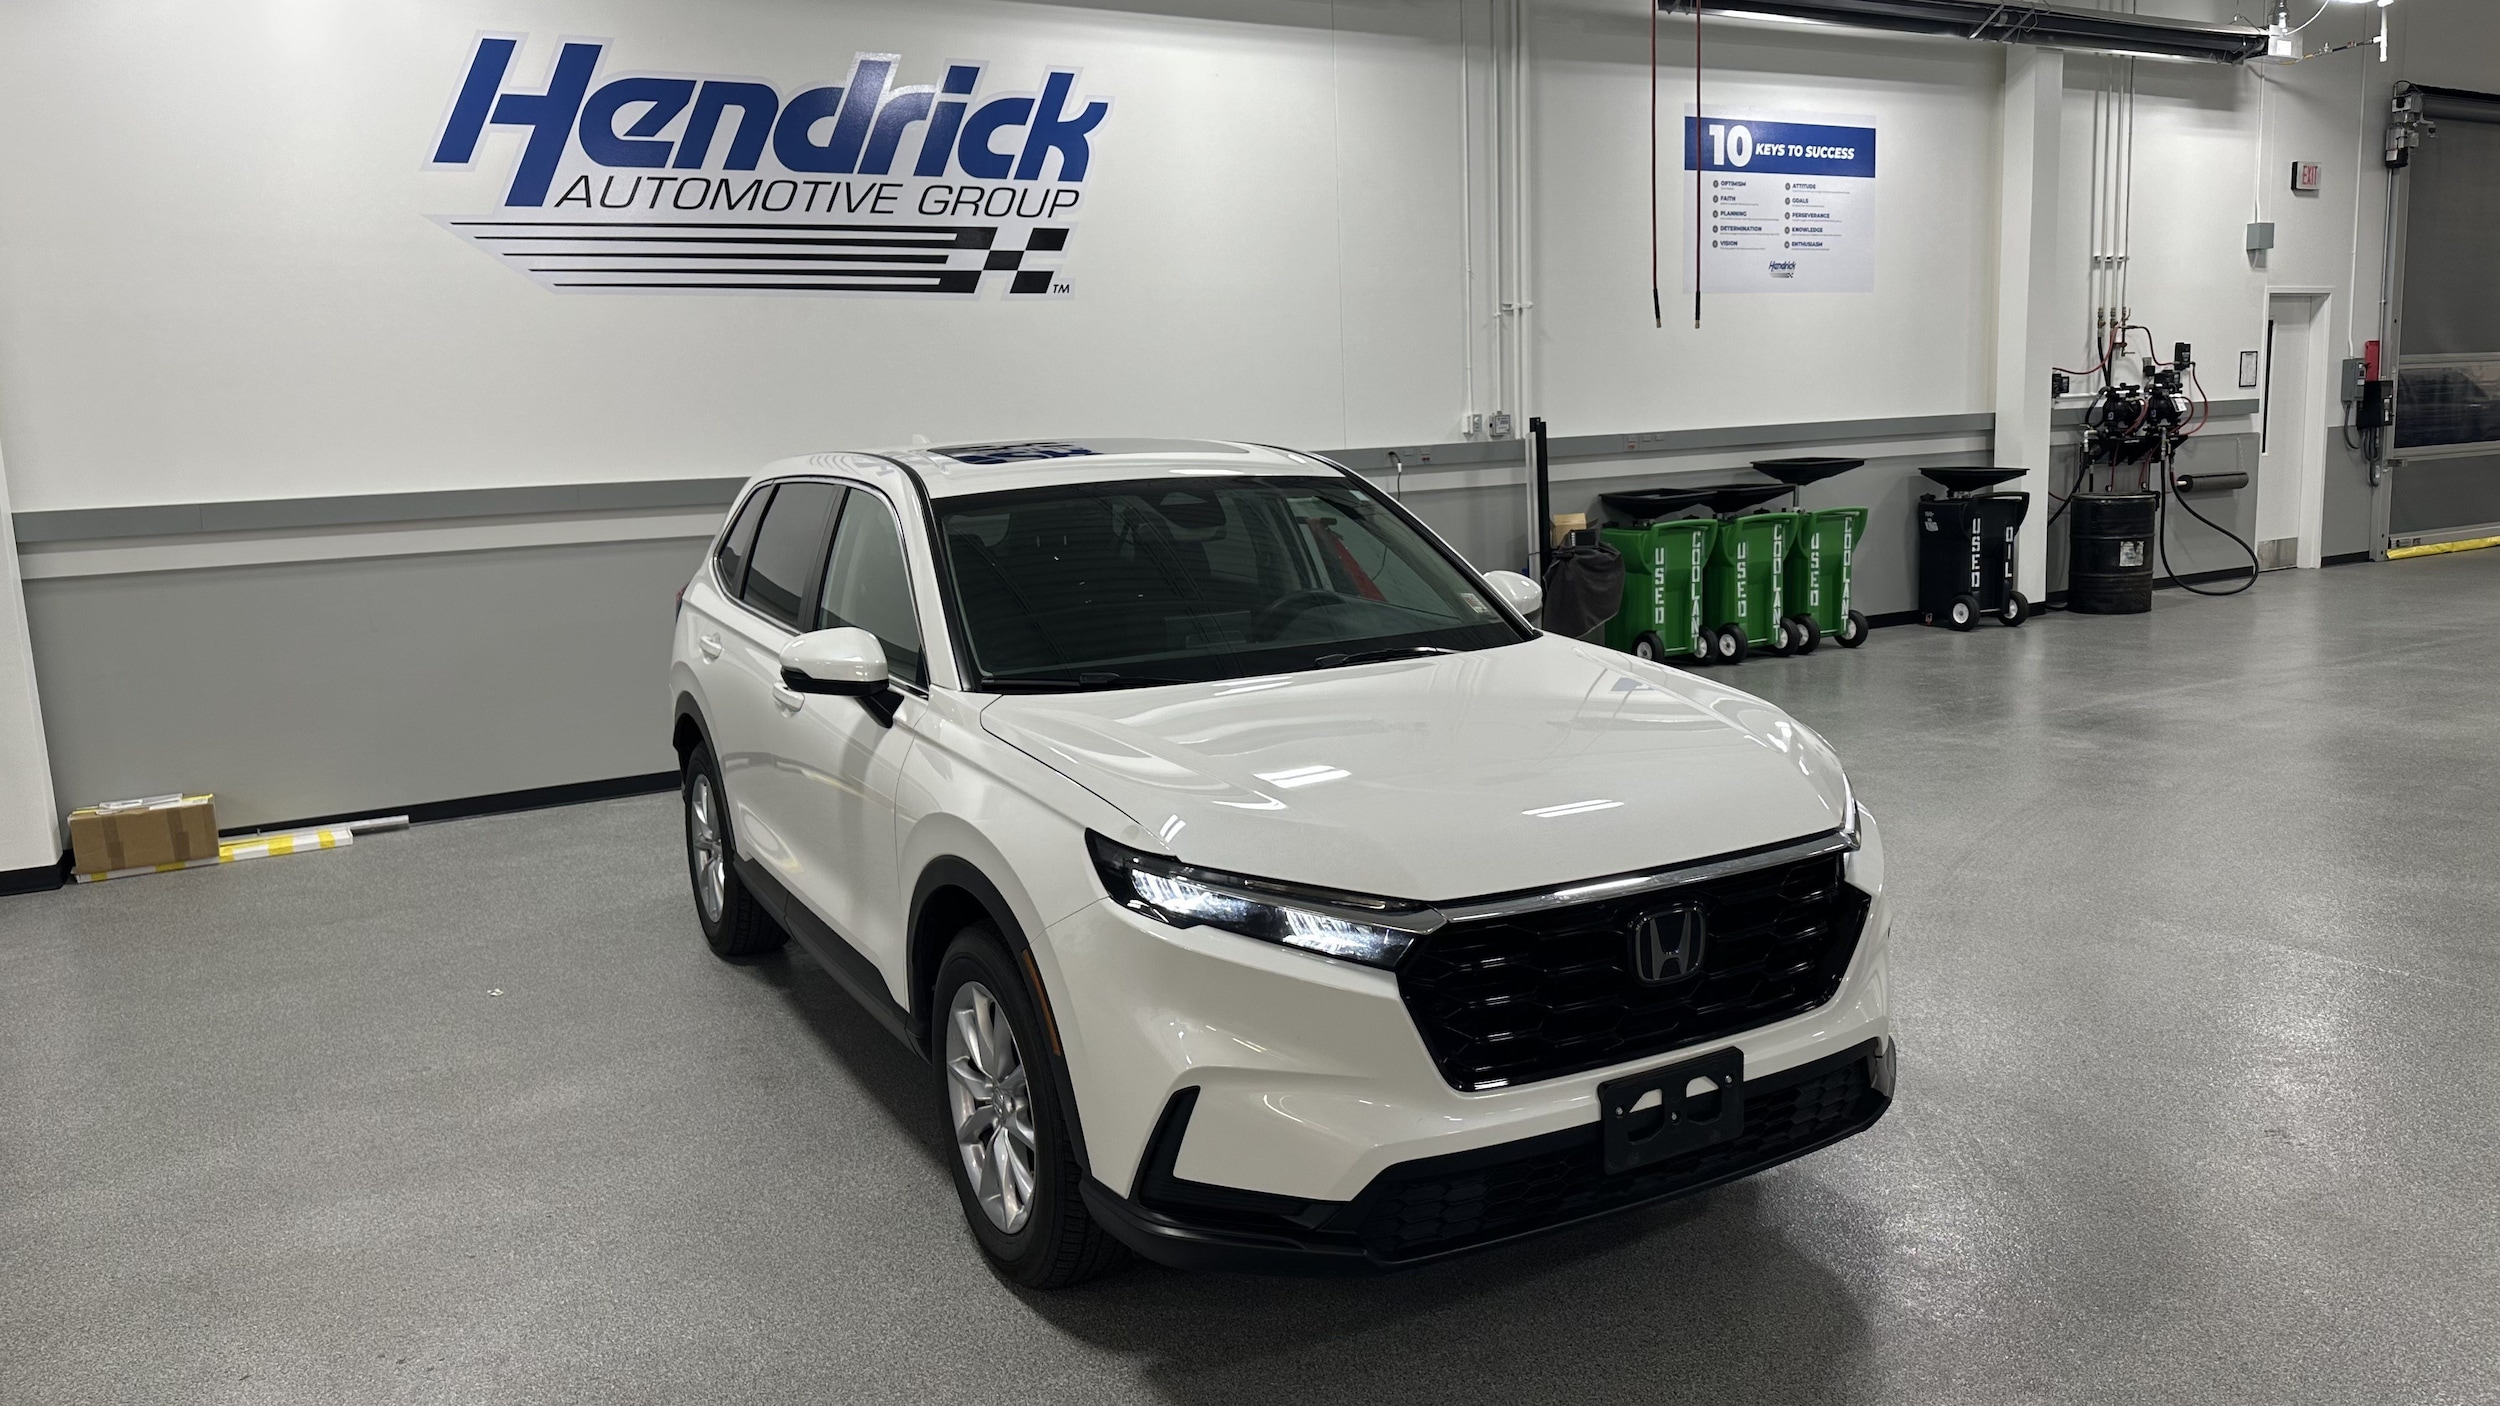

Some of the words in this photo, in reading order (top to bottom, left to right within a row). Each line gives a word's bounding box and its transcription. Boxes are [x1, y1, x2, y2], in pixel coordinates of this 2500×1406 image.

[433, 38, 1108, 207] Hendrick
[1709, 124, 1753, 167] 10
[1755, 143, 1786, 157] KEYS
[1787, 145, 1804, 157] TO
[1805, 146, 1855, 160] SUCCESS
[554, 174, 904, 214] AUTOMOTIVE
[918, 185, 1080, 218] GROUP
[2302, 165, 2318, 186] EXIT
[1655, 547, 1664, 624] USED
[1737, 541, 1747, 617] USED
[1772, 523, 1782, 641] COOLANT
[1810, 532, 1820, 607] USED
[1841, 516, 1852, 631] COOLANT
[1971, 517, 1980, 588] USED
[2004, 526, 2013, 578] OIL
[1691, 530, 1701, 651] COOLANT
